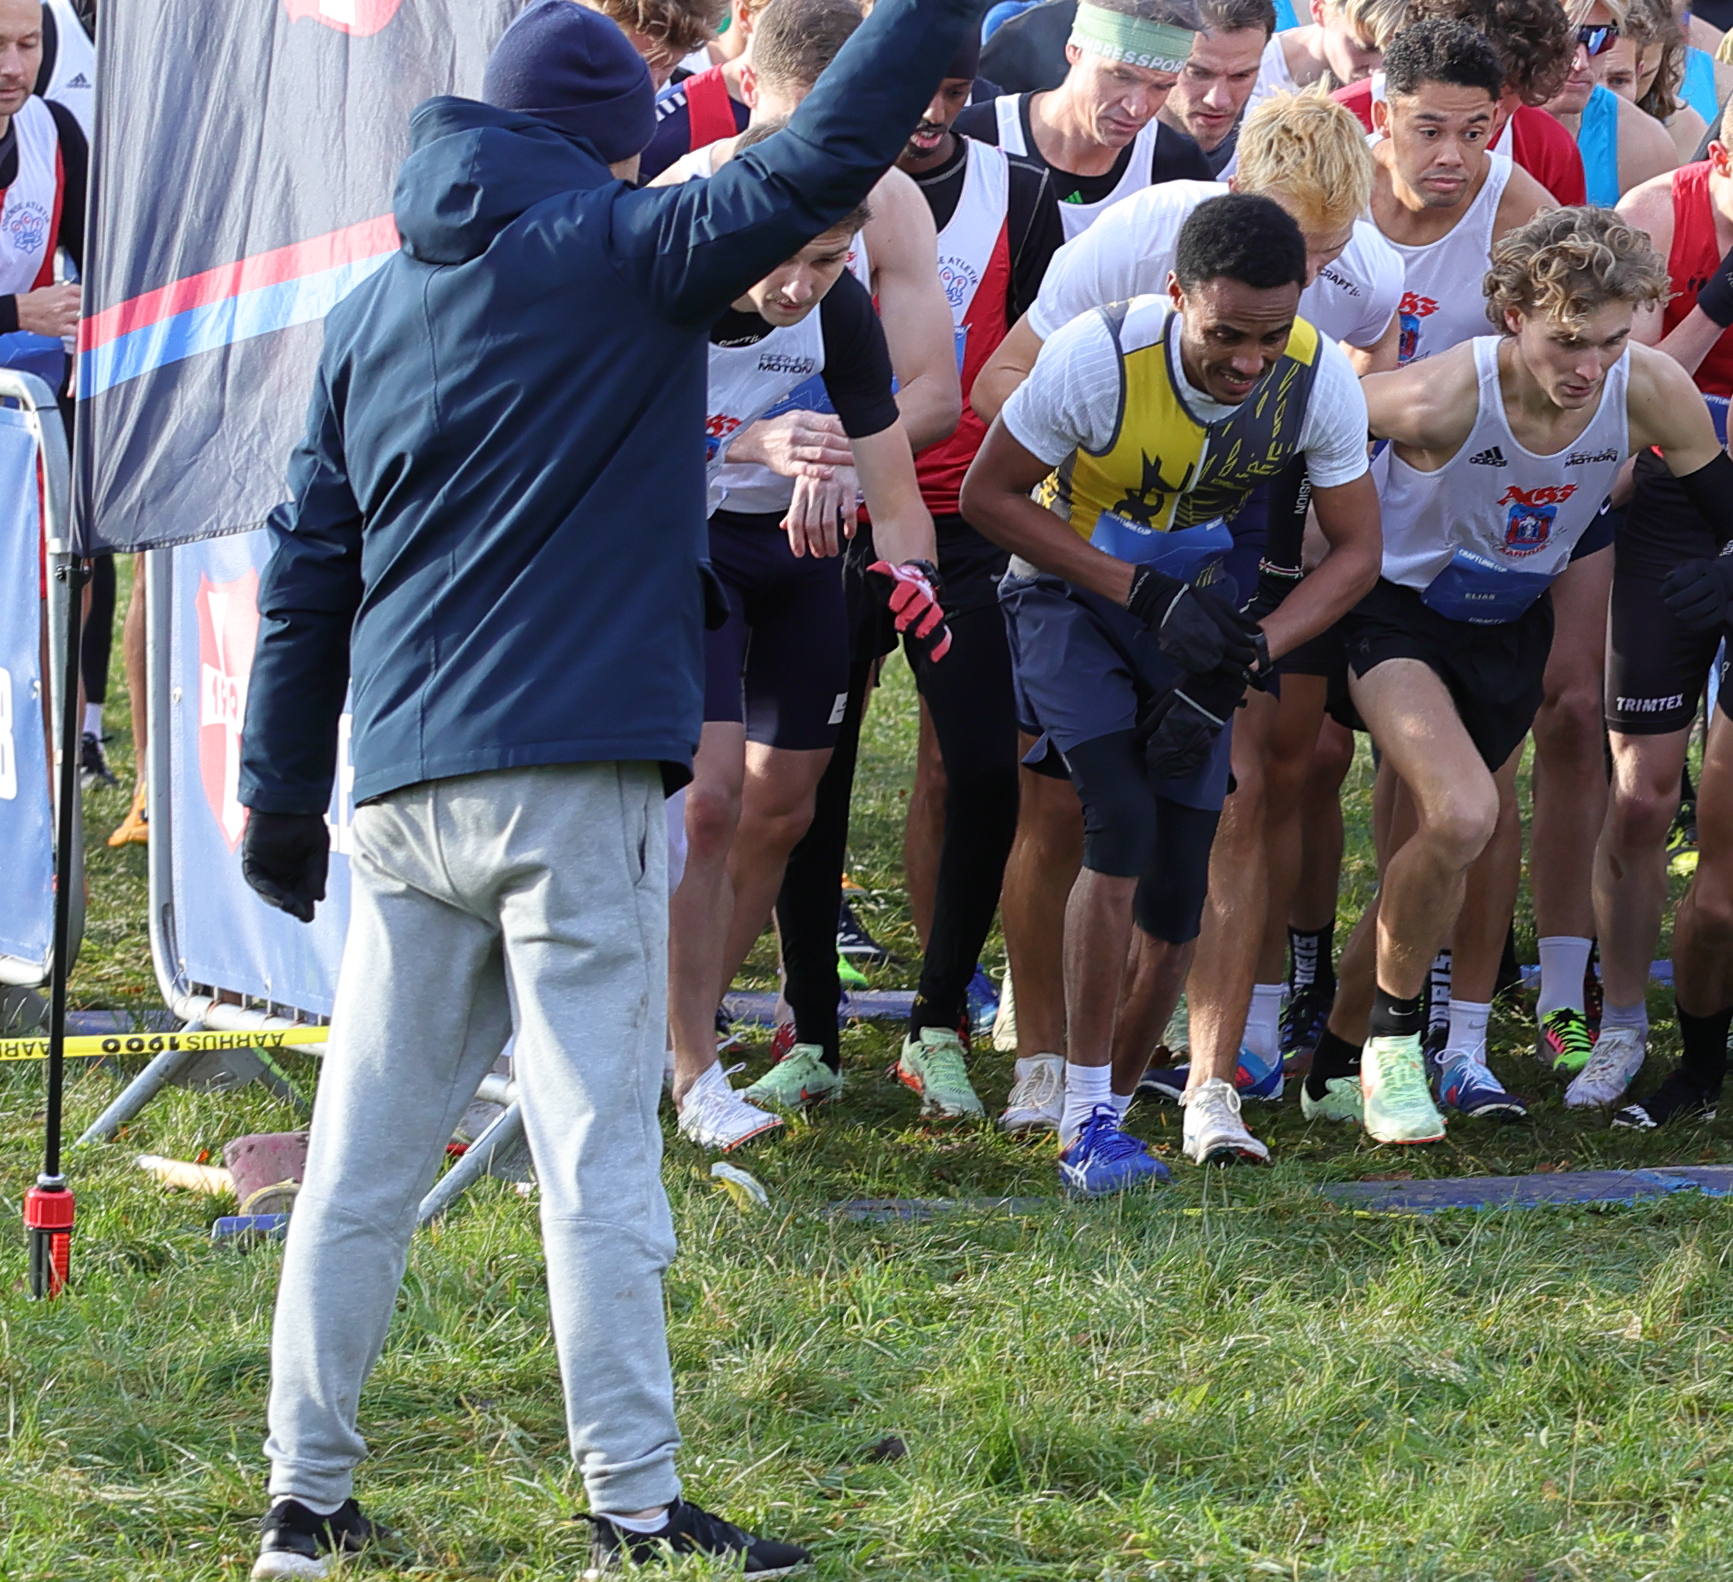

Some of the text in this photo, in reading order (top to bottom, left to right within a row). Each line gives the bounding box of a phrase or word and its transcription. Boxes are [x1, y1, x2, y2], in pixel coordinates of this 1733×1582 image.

[948, 256, 978, 286] ATLETIK
[757, 362, 813, 376] MOTION
[1469, 457, 1508, 467] adidas
[1563, 454, 1617, 468] MOTION
[1499, 542, 1547, 559] AARHUS
[1616, 692, 1684, 715] TRIMTEX
